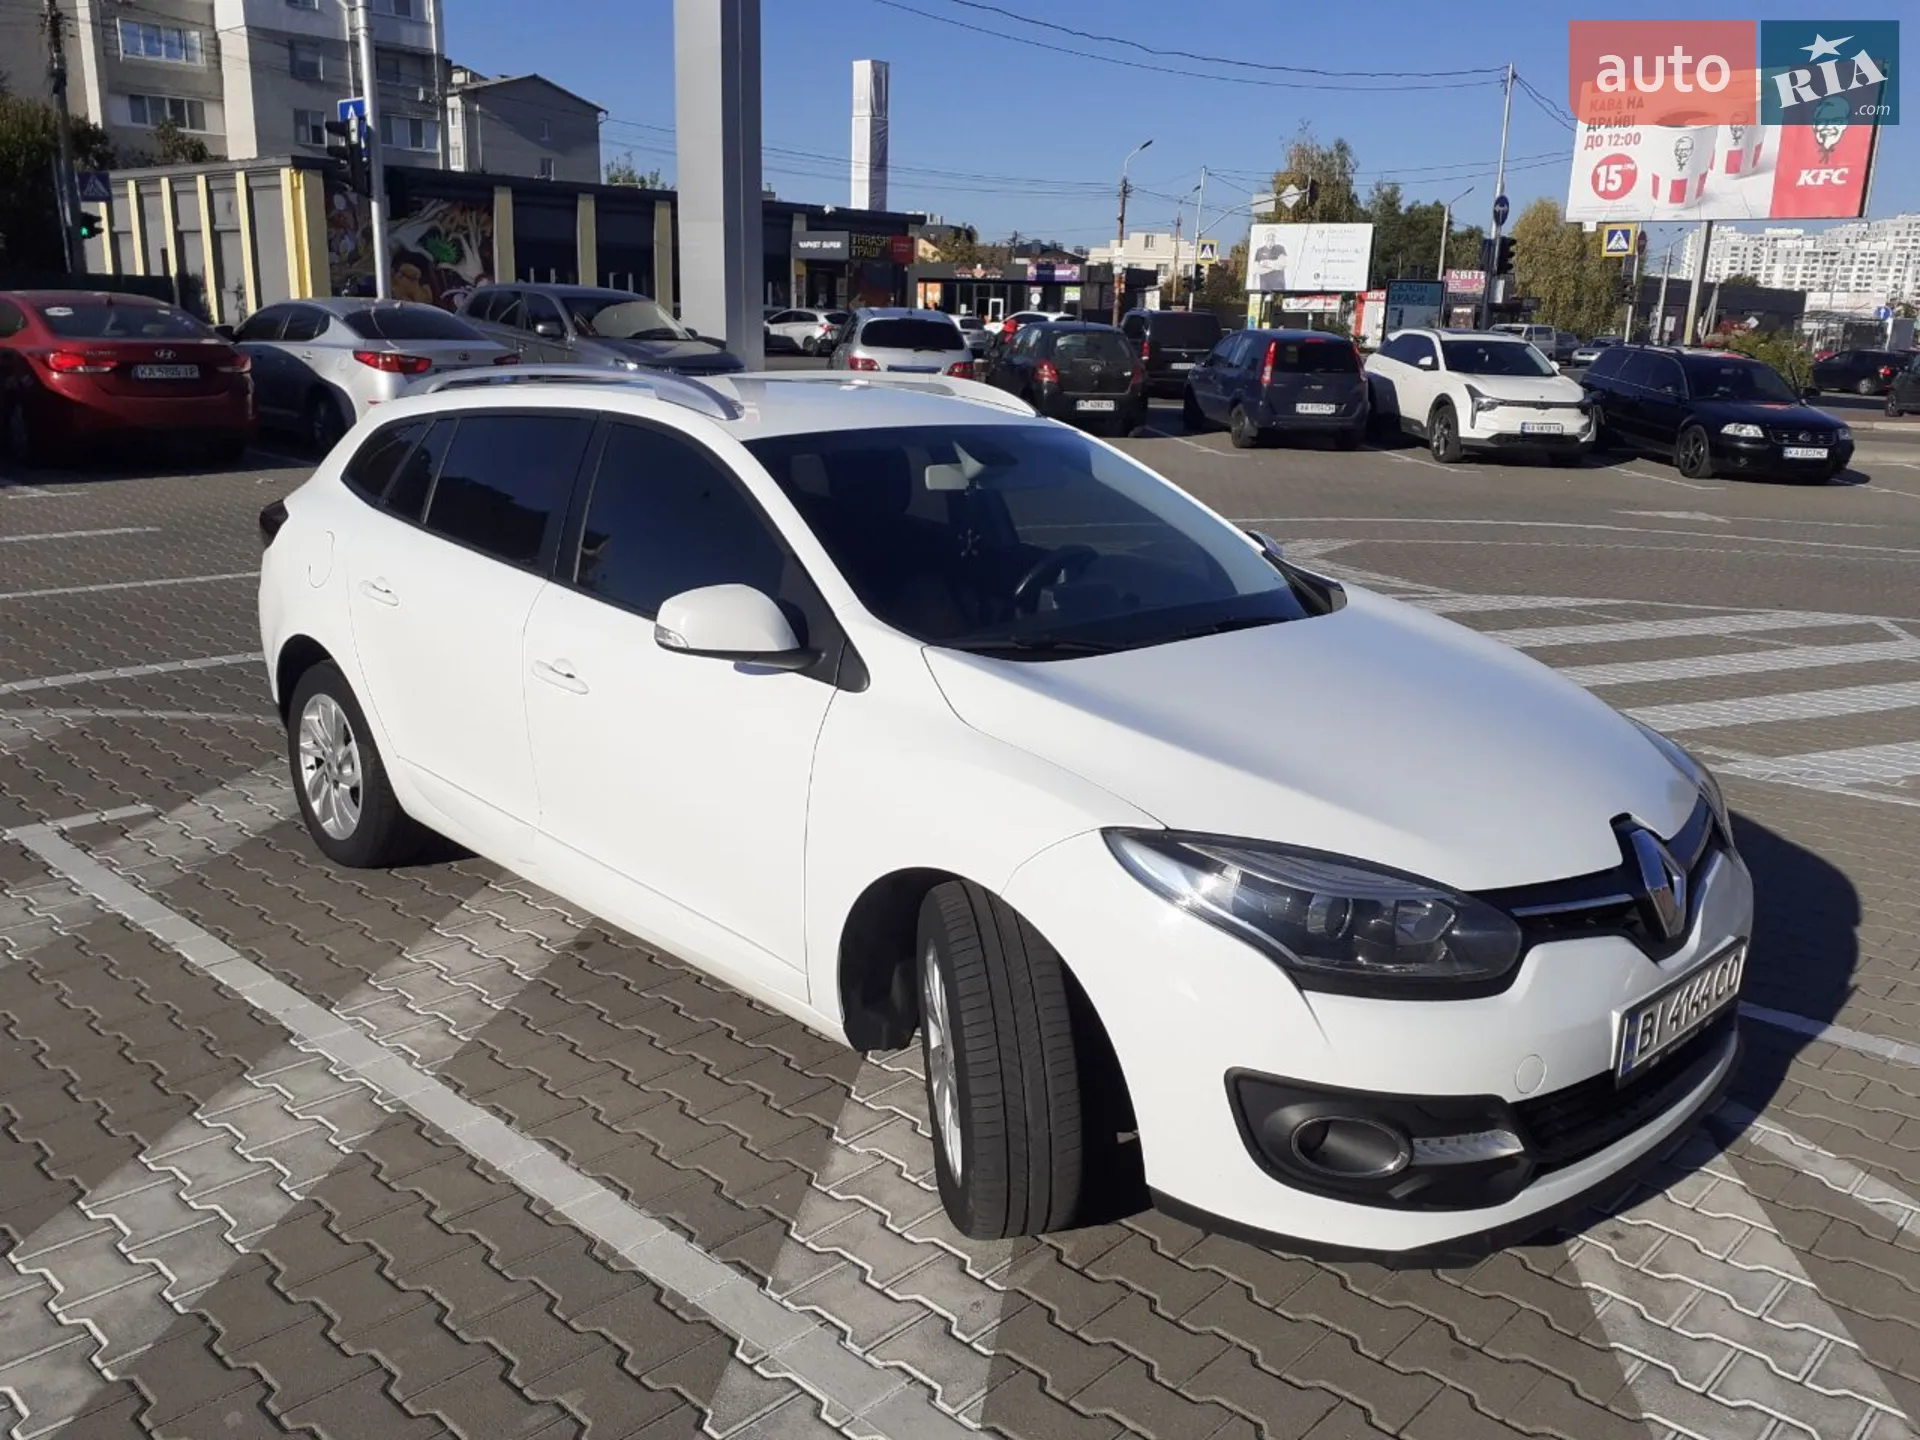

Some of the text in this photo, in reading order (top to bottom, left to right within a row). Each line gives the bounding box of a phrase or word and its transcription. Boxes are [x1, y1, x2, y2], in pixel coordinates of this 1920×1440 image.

[1589, 96, 1644, 112] КАВА НА
[1584, 132, 1642, 150] ДО 12:00
[1596, 164, 1623, 192] 15
[1796, 168, 1849, 187] KFC
[1635, 1001, 1663, 1057] BI
[1712, 953, 1739, 1001] CO
